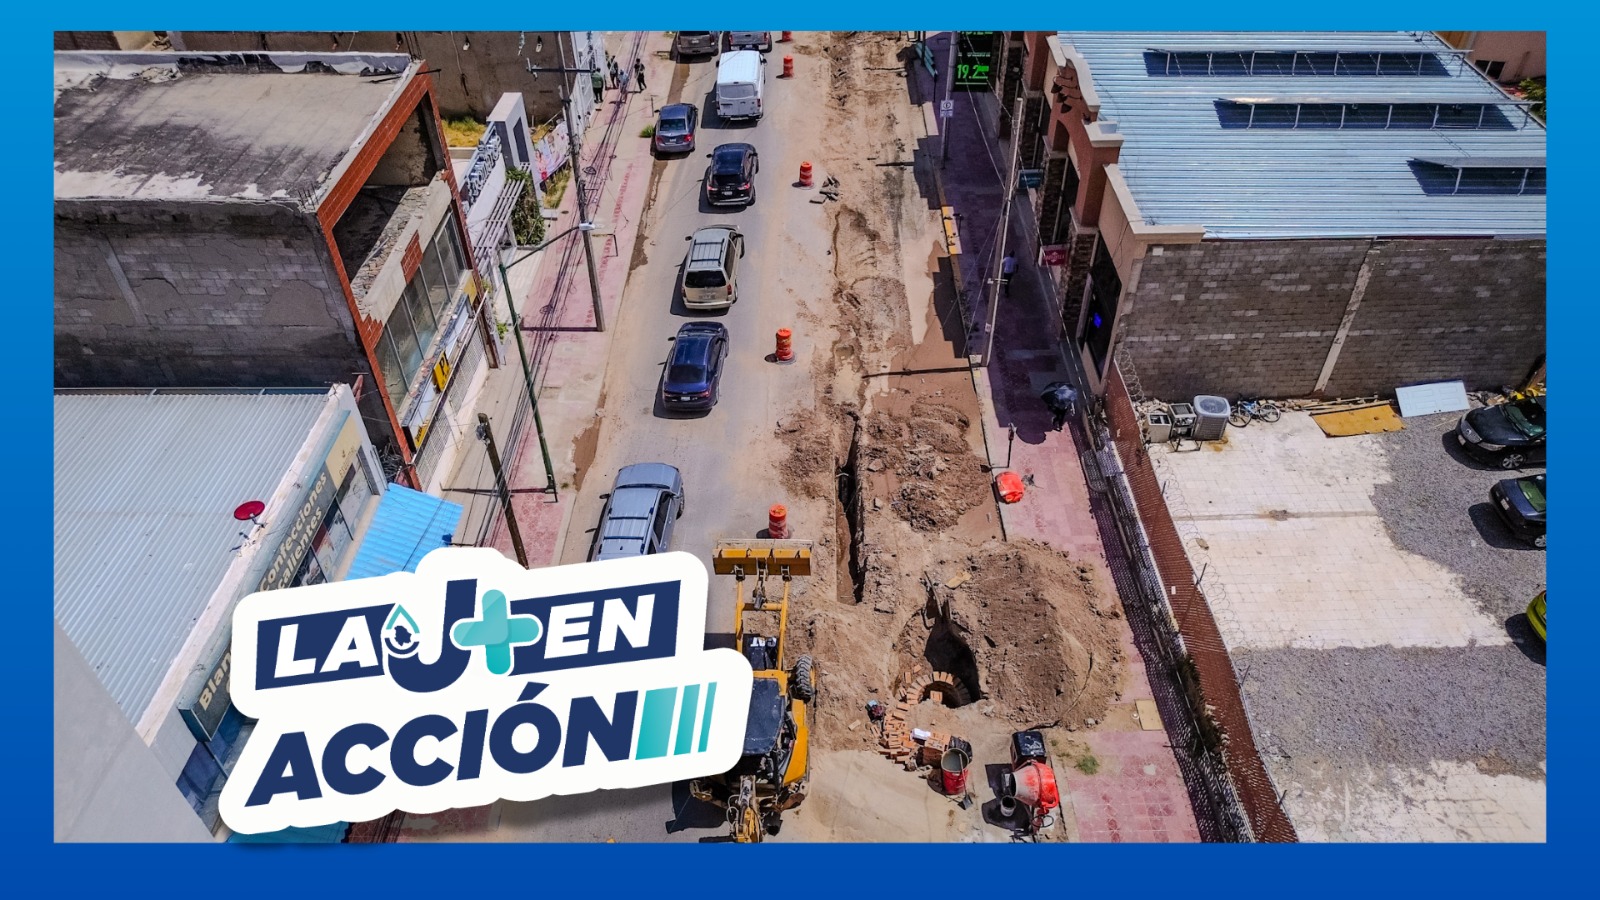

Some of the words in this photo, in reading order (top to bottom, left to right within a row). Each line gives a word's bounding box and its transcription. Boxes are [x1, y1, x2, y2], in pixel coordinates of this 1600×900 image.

[957, 64, 989, 79] 19.2
[259, 472, 327, 592] Confecciones
[277, 507, 322, 590] calientes
